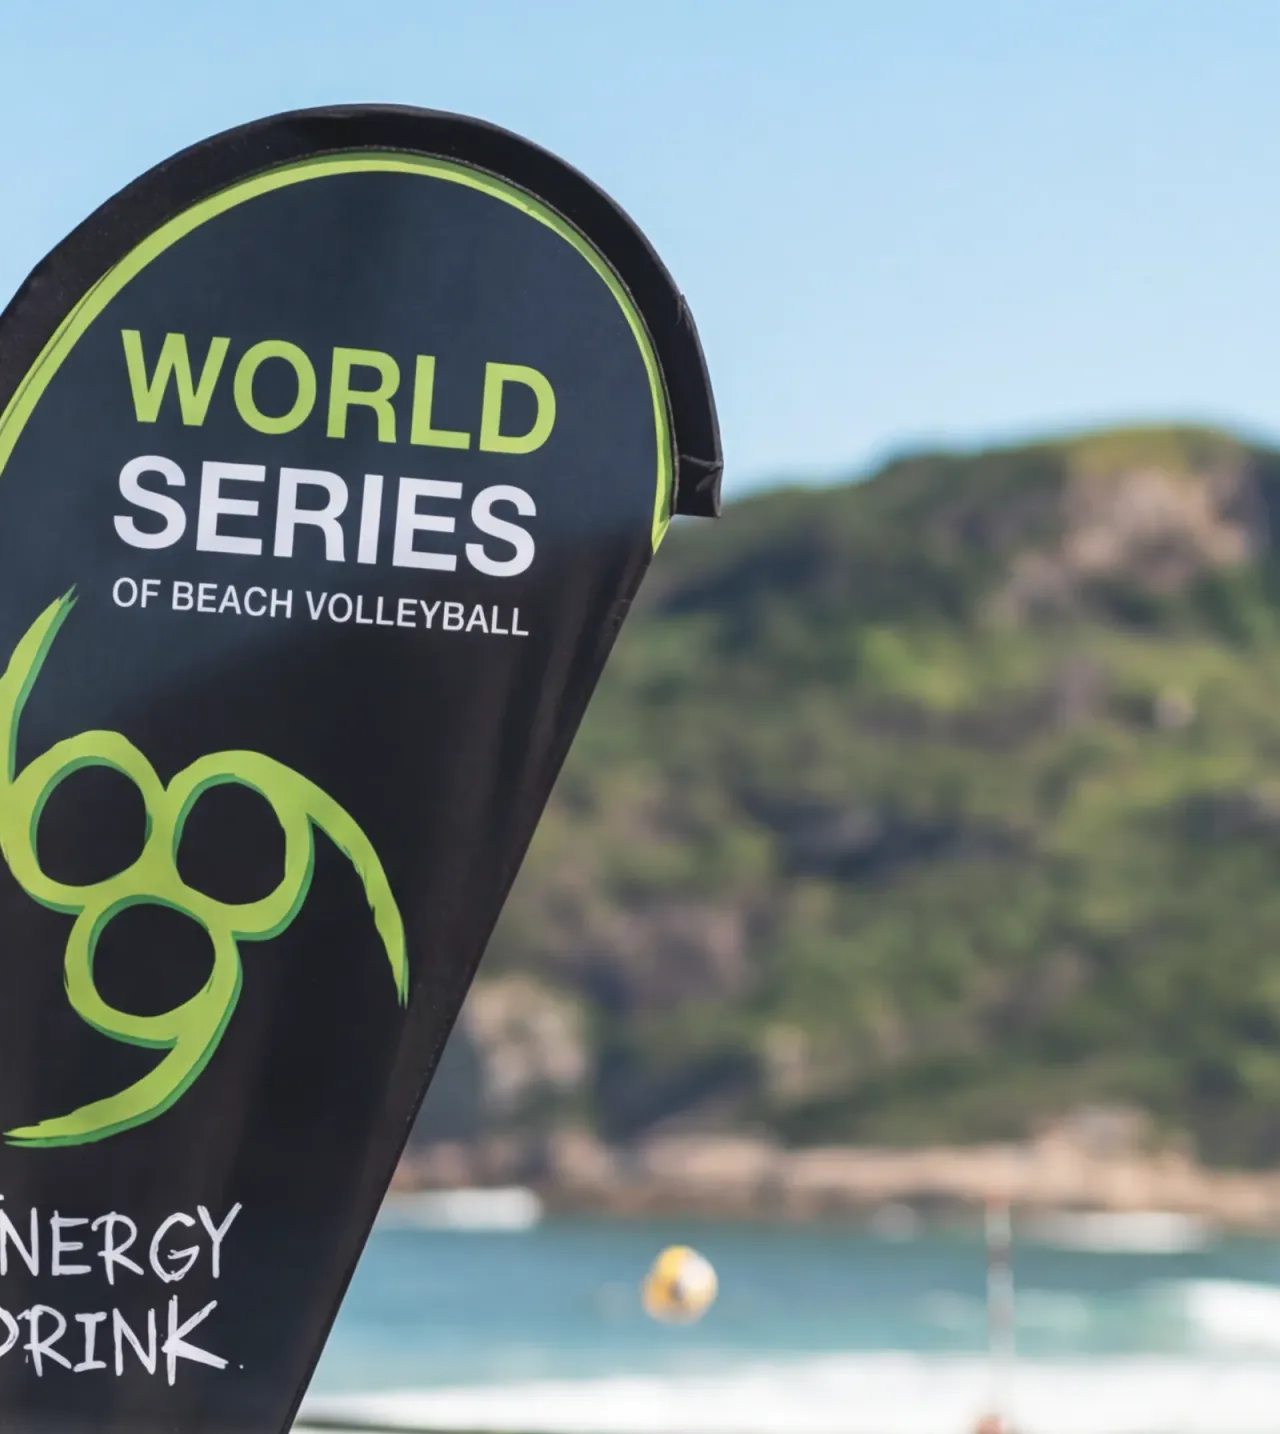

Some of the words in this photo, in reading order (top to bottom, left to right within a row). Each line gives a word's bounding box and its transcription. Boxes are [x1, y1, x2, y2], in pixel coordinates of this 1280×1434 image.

[120, 329, 557, 455] WORLD
[113, 454, 537, 578] SERIES
[112, 576, 162, 609] OF
[171, 580, 293, 619] BEACH
[305, 590, 529, 637] VOLLEYBALL
